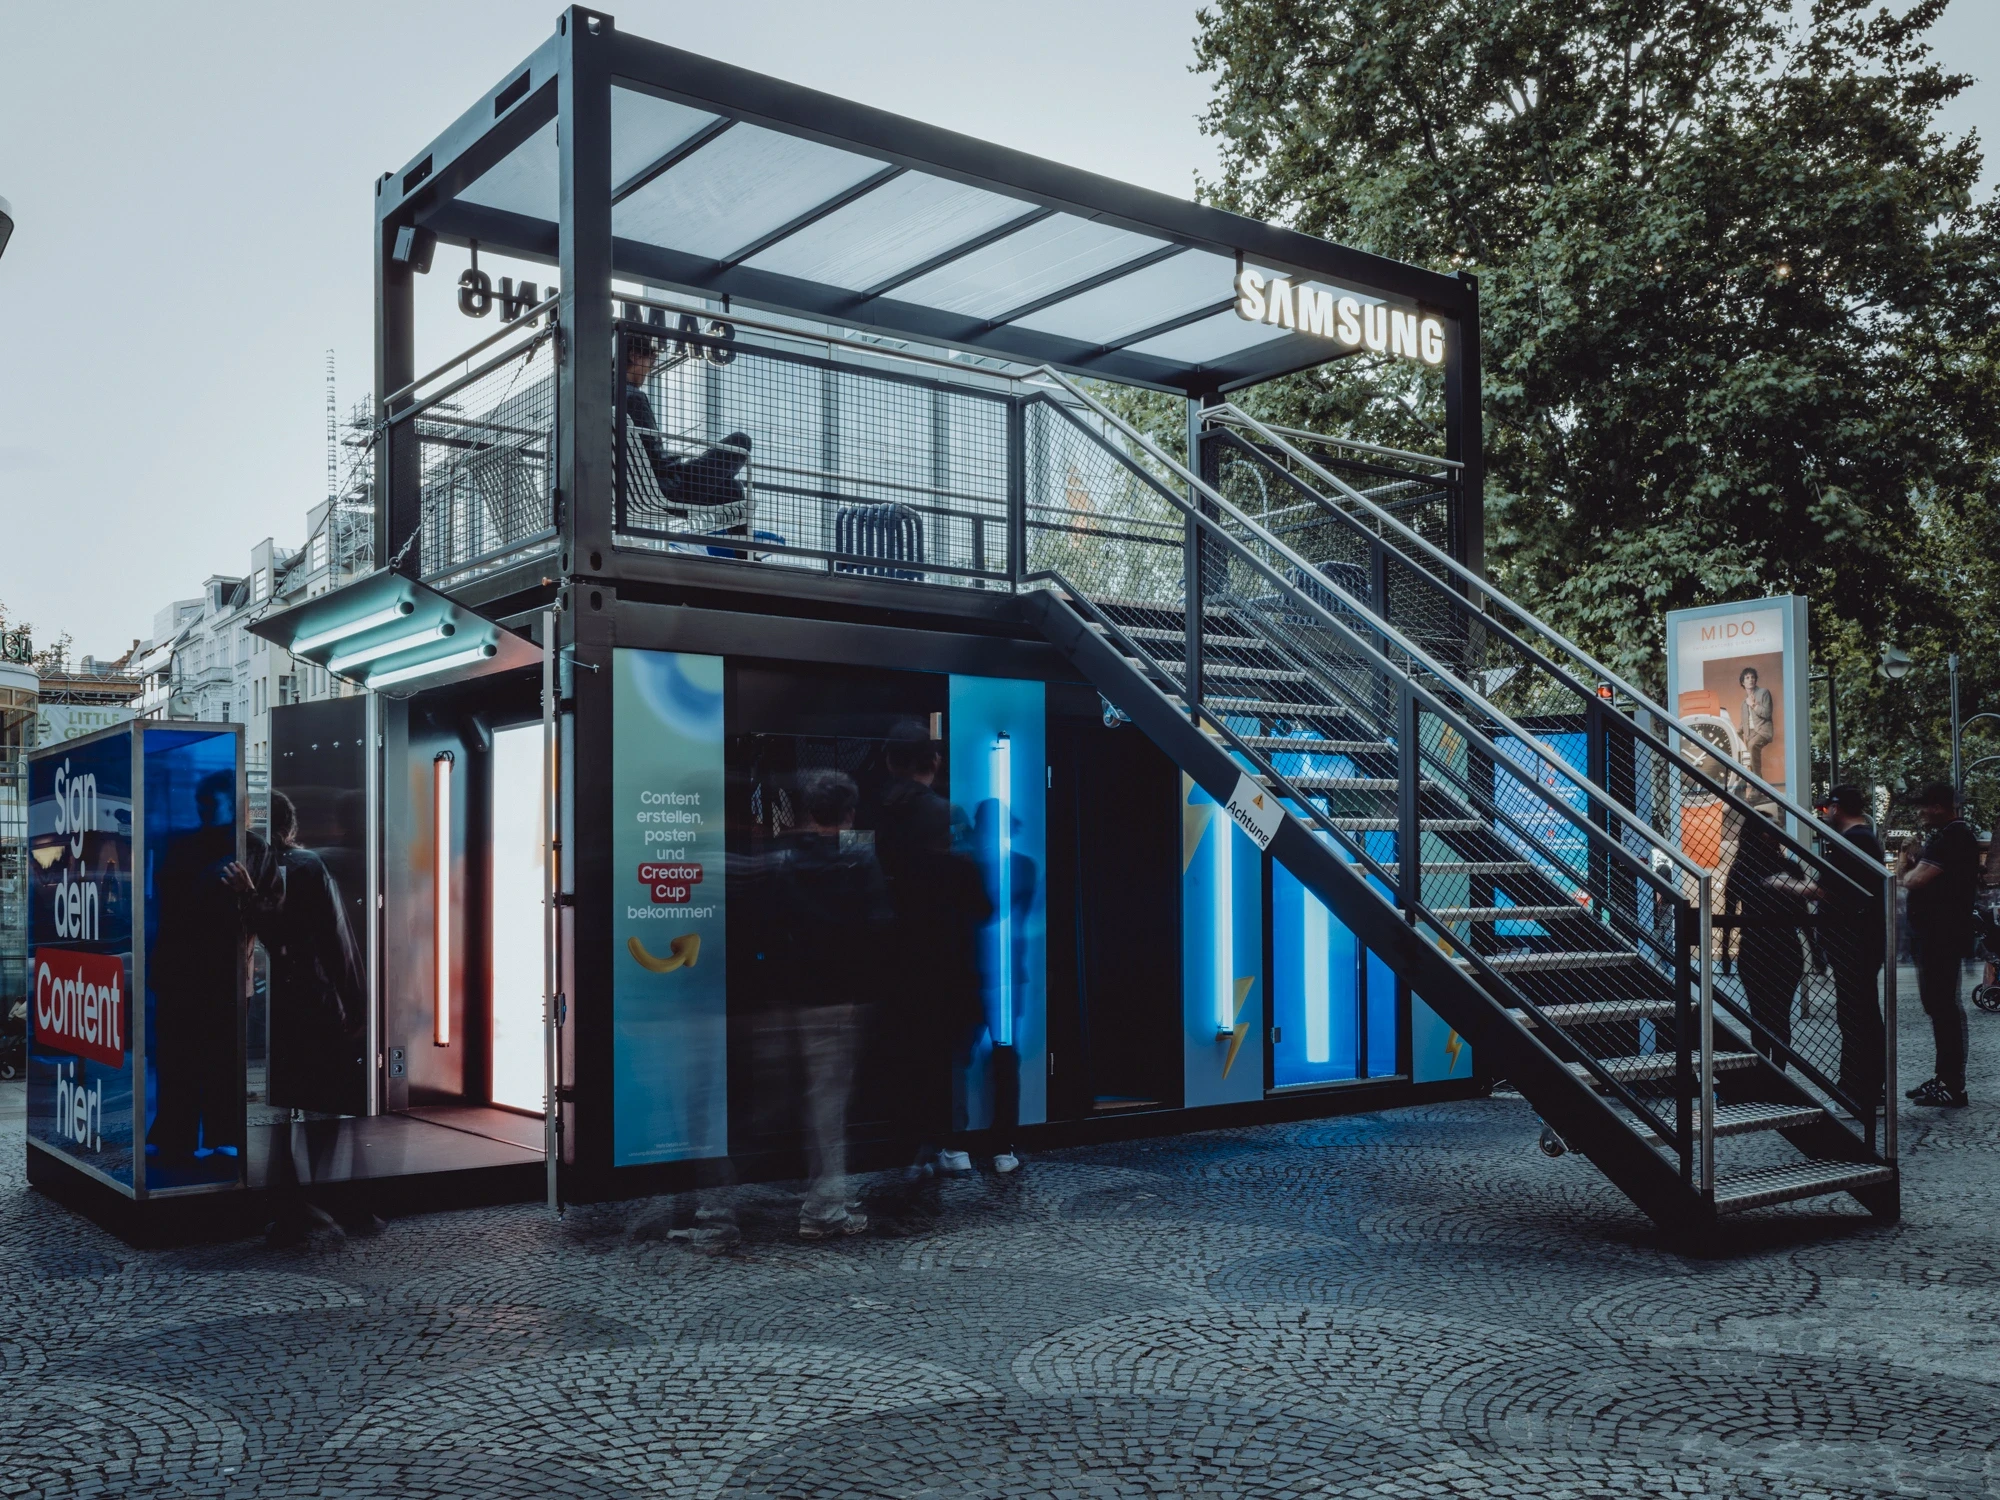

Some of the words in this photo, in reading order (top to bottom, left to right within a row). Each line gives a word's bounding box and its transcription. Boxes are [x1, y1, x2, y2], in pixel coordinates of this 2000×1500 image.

[1236, 269, 1444, 364] SAMSUNG
[1701, 620, 1755, 641] MIDO
[69, 711, 120, 726] LITTLE
[64, 727, 99, 740] GR
[640, 791, 700, 805] Content
[54, 757, 97, 859] Sign
[636, 810, 704, 825] erstellen,
[1227, 800, 1269, 847] Achtung
[644, 828, 696, 845] posten
[656, 847, 685, 860] und
[641, 866, 700, 879] Creator
[54, 860, 99, 941] dein
[655, 884, 686, 902] Cup
[37, 961, 120, 1051] Content
[56, 1061, 102, 1153] hier!
